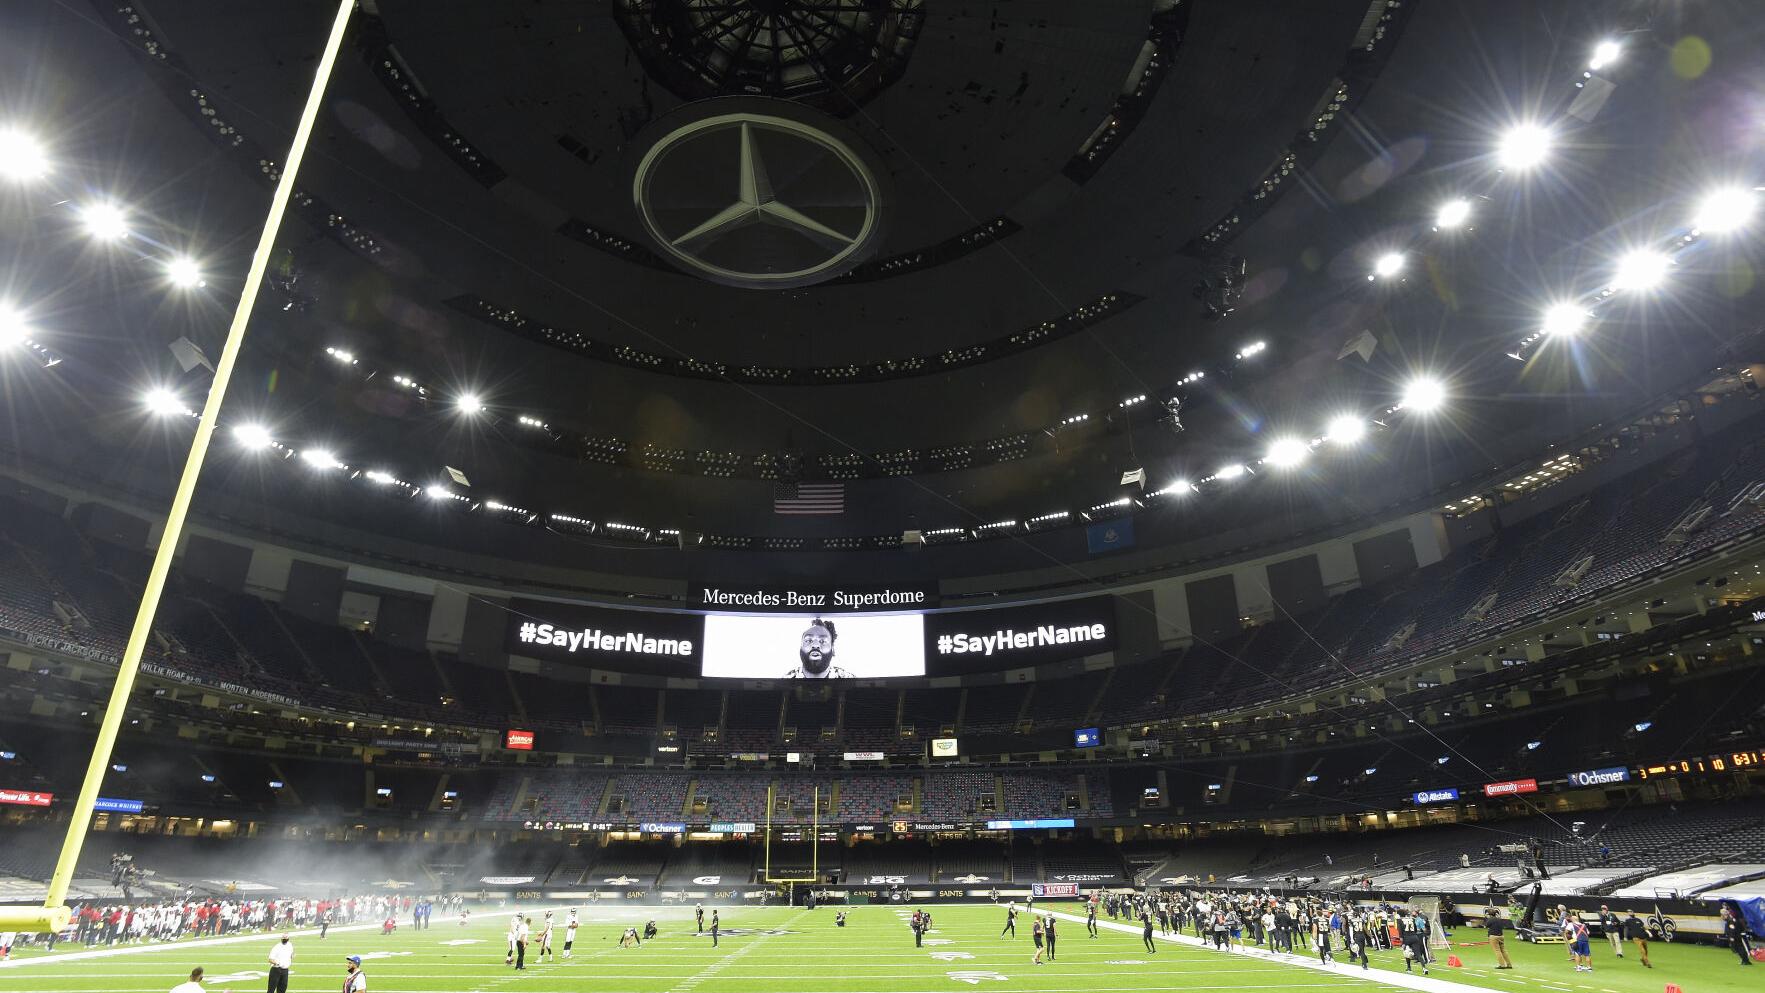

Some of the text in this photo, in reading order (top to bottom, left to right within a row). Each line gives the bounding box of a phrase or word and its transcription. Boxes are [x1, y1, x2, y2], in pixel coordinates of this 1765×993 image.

[703, 588, 925, 608] Mercedes-Benz Superdome
[519, 622, 693, 656] #SayHerName
[937, 622, 1106, 656] #SayHerName
[60, 642, 102, 659] JACKSON
[141, 662, 166, 674] WILLIE
[166, 668, 186, 680] ROAF
[220, 681, 249, 694] MORTEN
[1681, 761, 1689, 772] 0
[1698, 762, 1705, 772] 1
[1713, 759, 1725, 771] 10
[1733, 752, 1758, 766] 6:31
[1579, 771, 1624, 786] Ochsner
[1487, 782, 1518, 793] Community
[1428, 791, 1454, 801] Allstate
[649, 823, 682, 833] Ochsner
[894, 822, 906, 831] 25
[516, 890, 541, 899] SAINTS
[626, 891, 648, 899] SAINT
[1045, 885, 1073, 895] KICKOFF
[1318, 921, 1329, 932] 55
